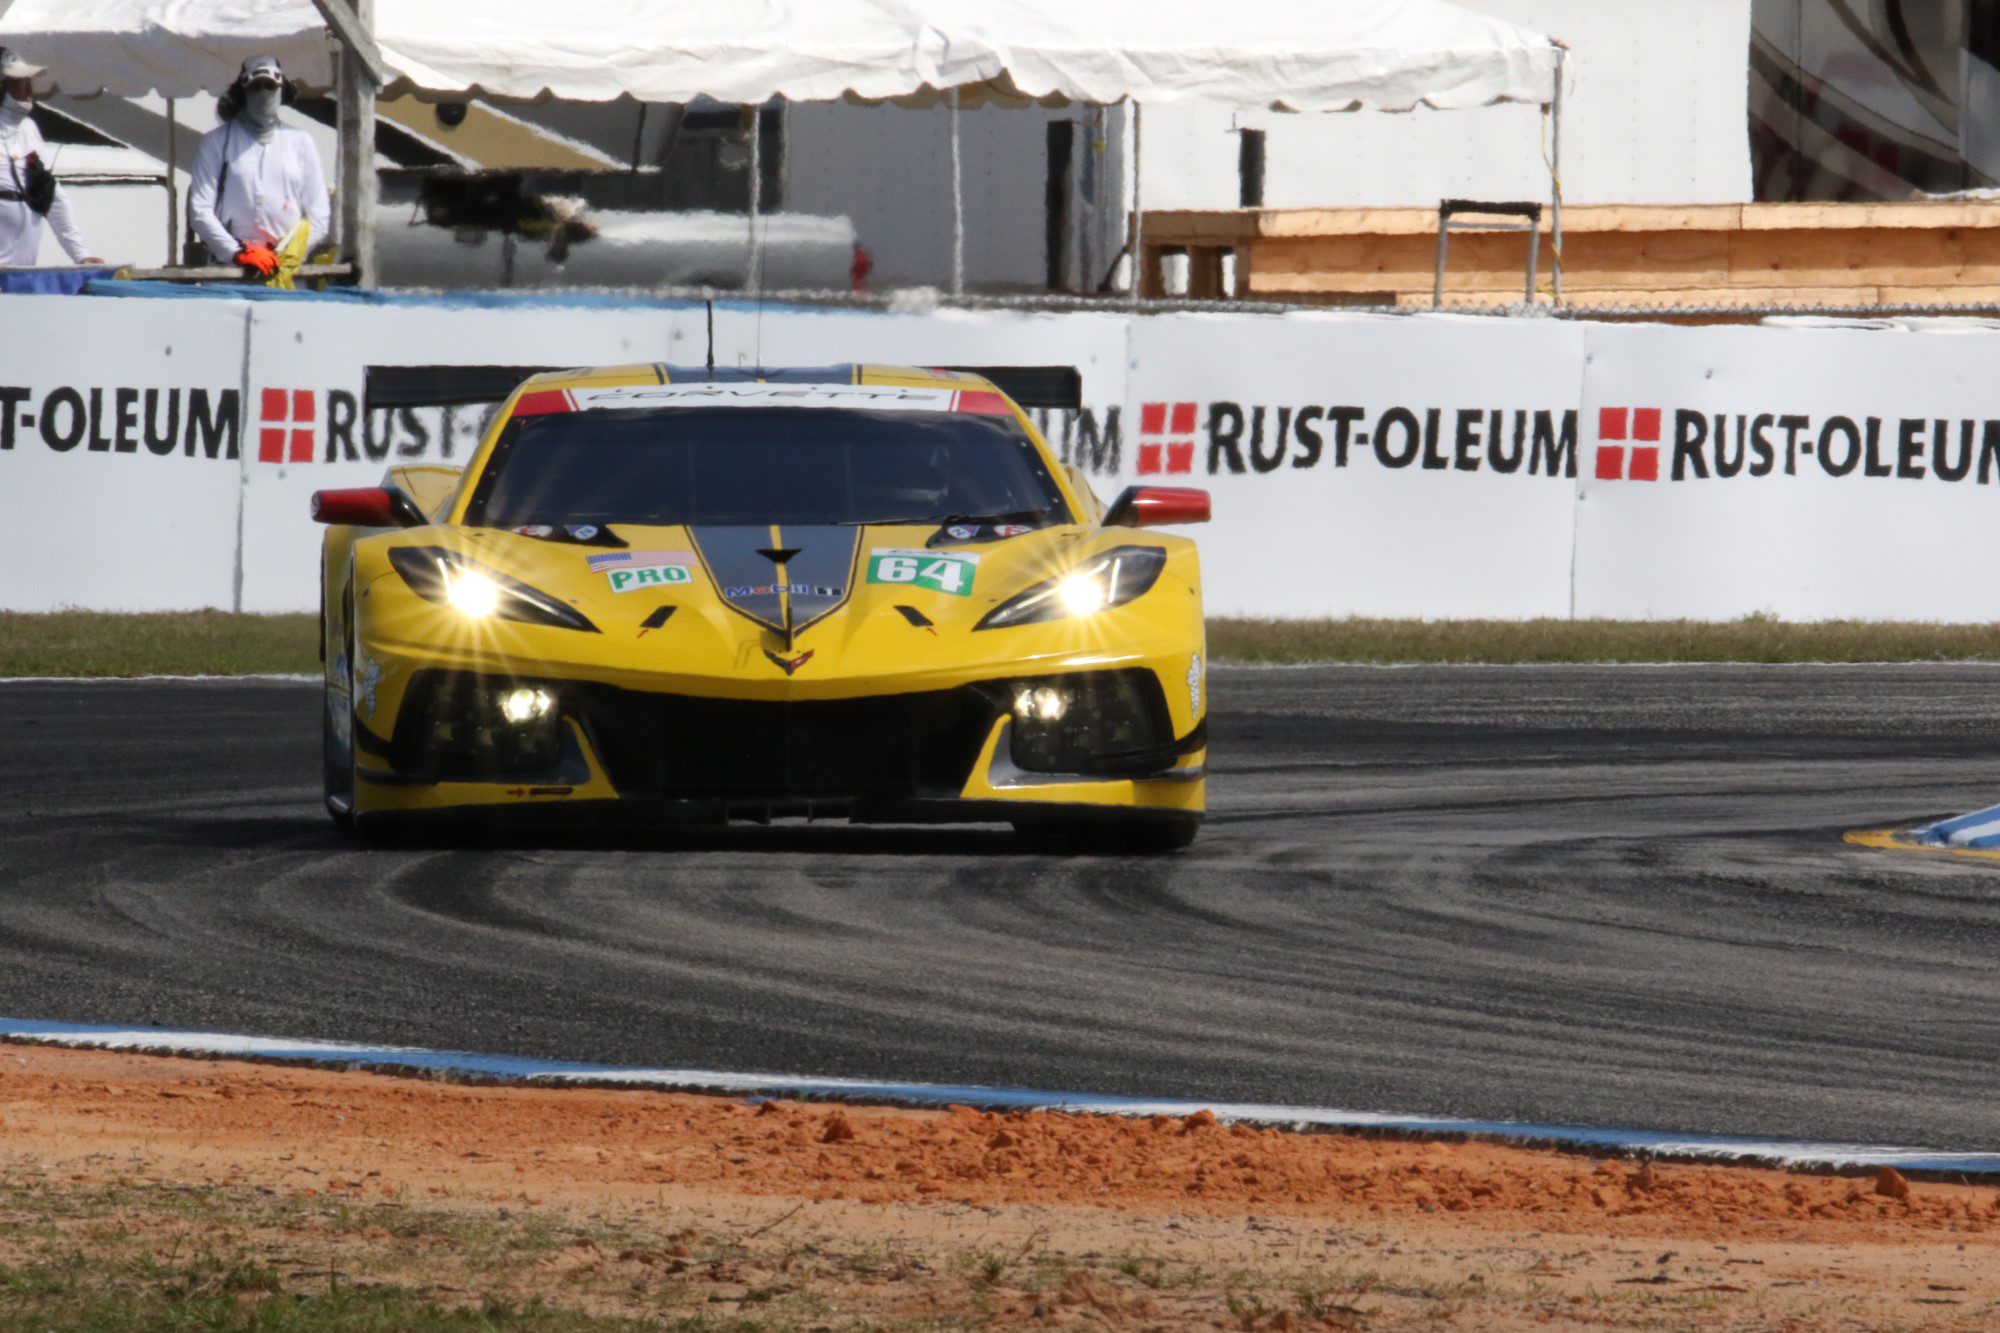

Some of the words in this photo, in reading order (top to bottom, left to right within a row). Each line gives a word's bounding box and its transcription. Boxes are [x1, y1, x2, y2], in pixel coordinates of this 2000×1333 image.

[587, 390, 939, 401] CORVETTE
[1207, 401, 1578, 478] RUST-OLEUM
[611, 566, 687, 590] PRO
[877, 557, 964, 593] 64
[724, 584, 809, 598] Mobil
